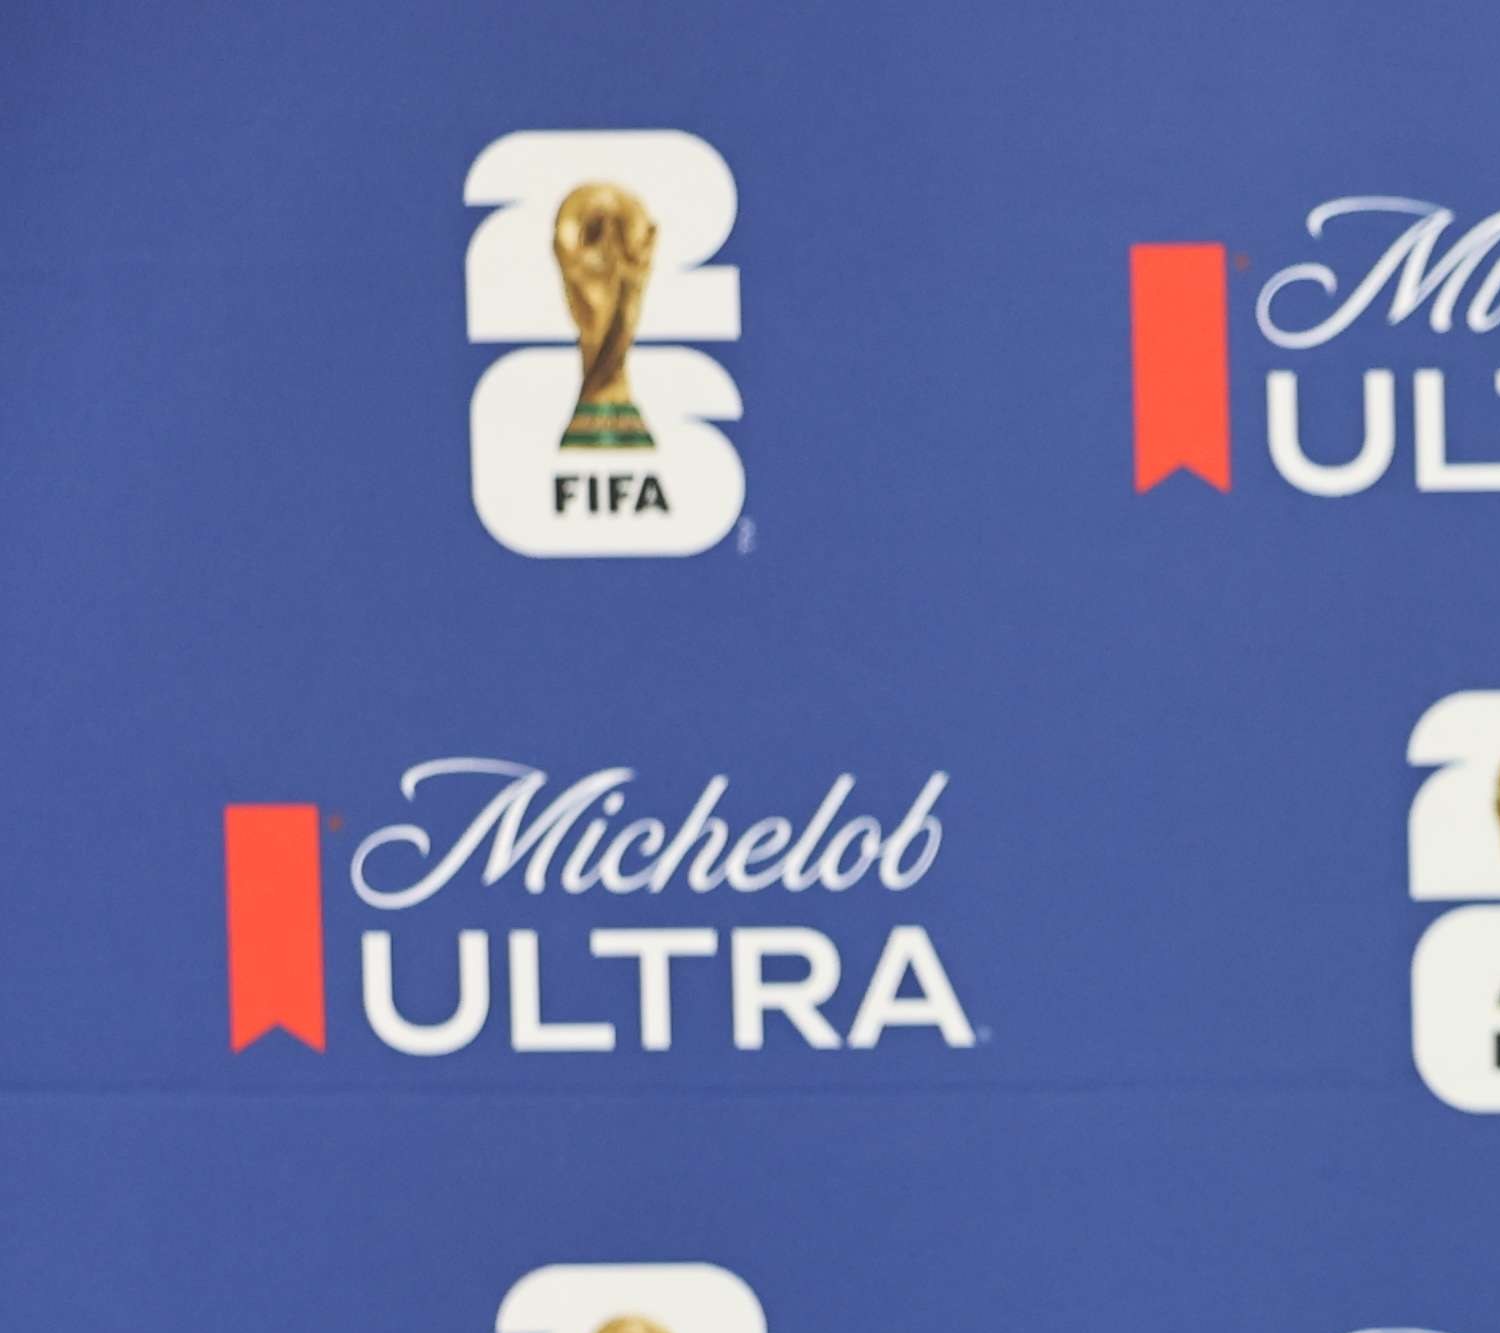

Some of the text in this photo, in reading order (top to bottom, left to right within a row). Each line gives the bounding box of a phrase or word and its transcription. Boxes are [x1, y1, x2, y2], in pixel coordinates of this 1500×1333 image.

[552, 473, 671, 516] FIFA
[349, 756, 950, 911] Michelob
[360, 924, 978, 1057] ULTRA
